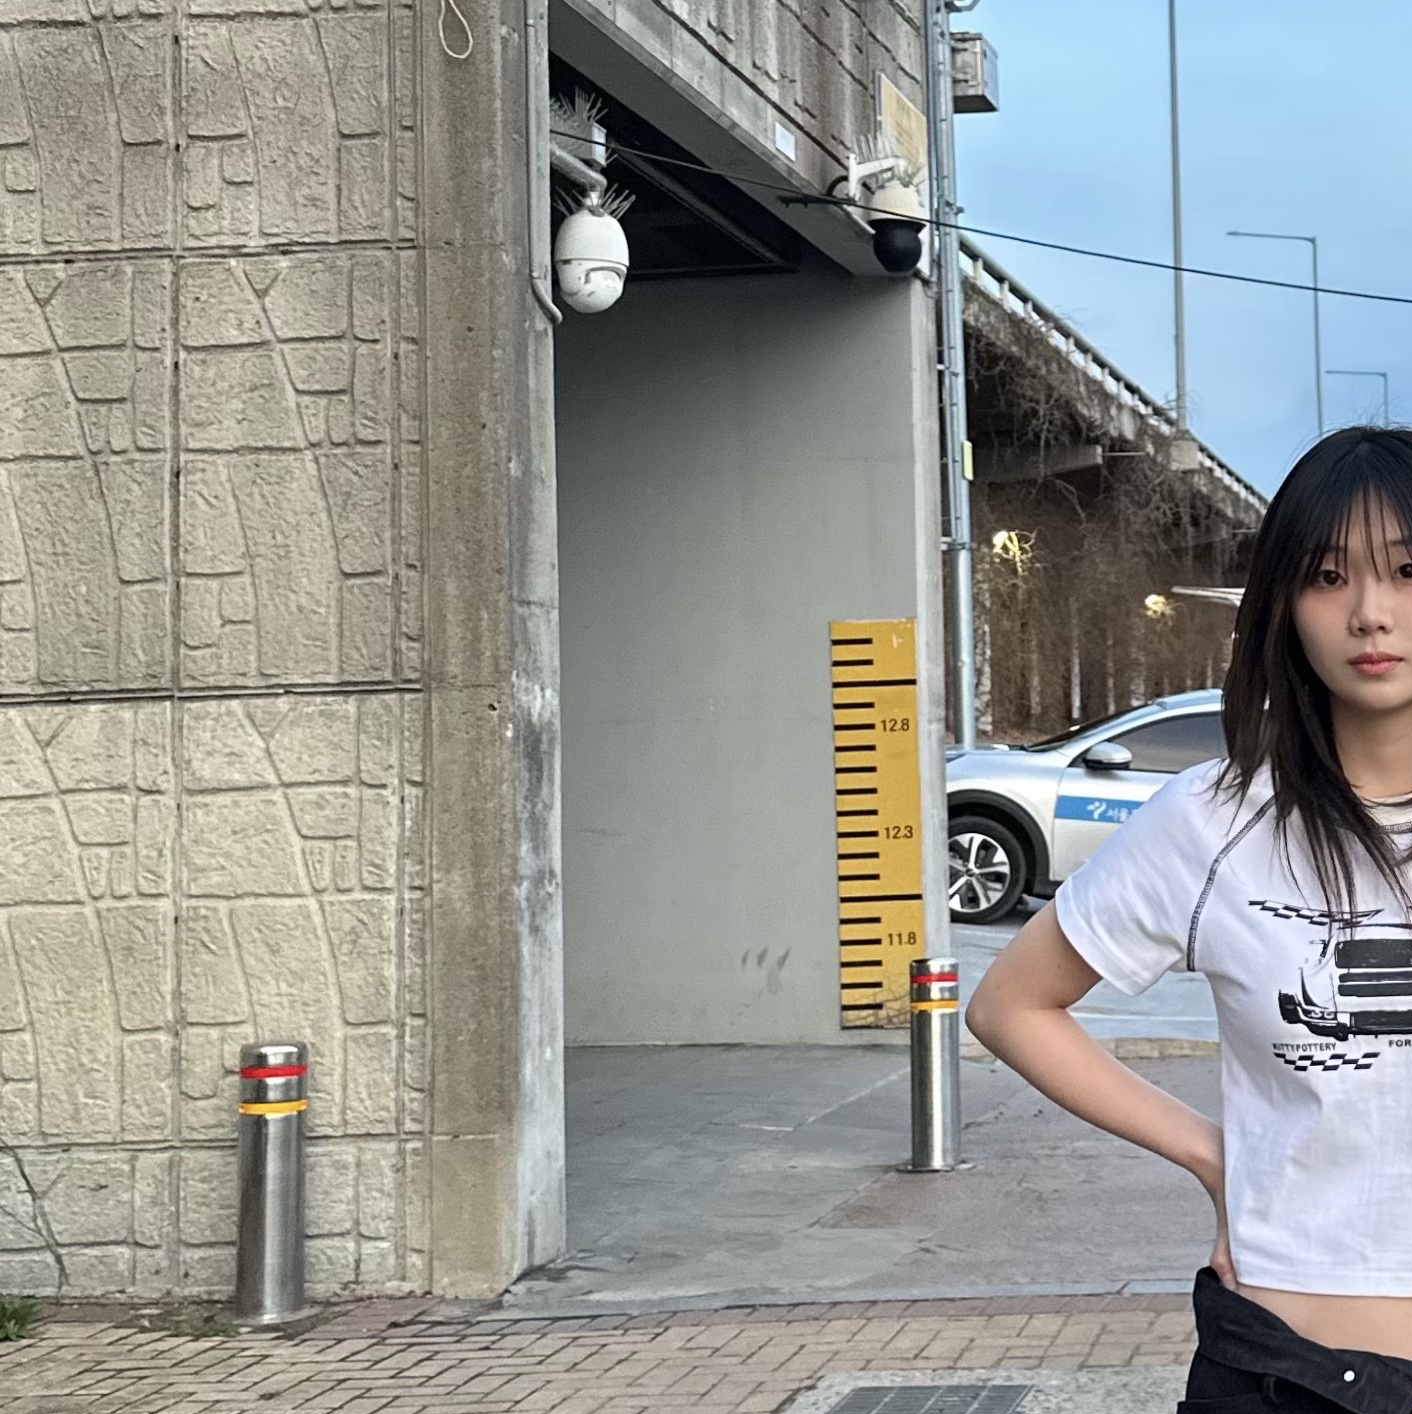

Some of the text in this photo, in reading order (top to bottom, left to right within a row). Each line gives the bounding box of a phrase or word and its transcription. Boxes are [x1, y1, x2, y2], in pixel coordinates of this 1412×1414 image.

[880, 718, 910, 733] 12.8
[883, 825, 914, 840] 12.3
[887, 931, 917, 946] 11.8
[1271, 1042, 1337, 1052] KITTYPOTTERY
[1388, 1038, 1412, 1048] FOR
